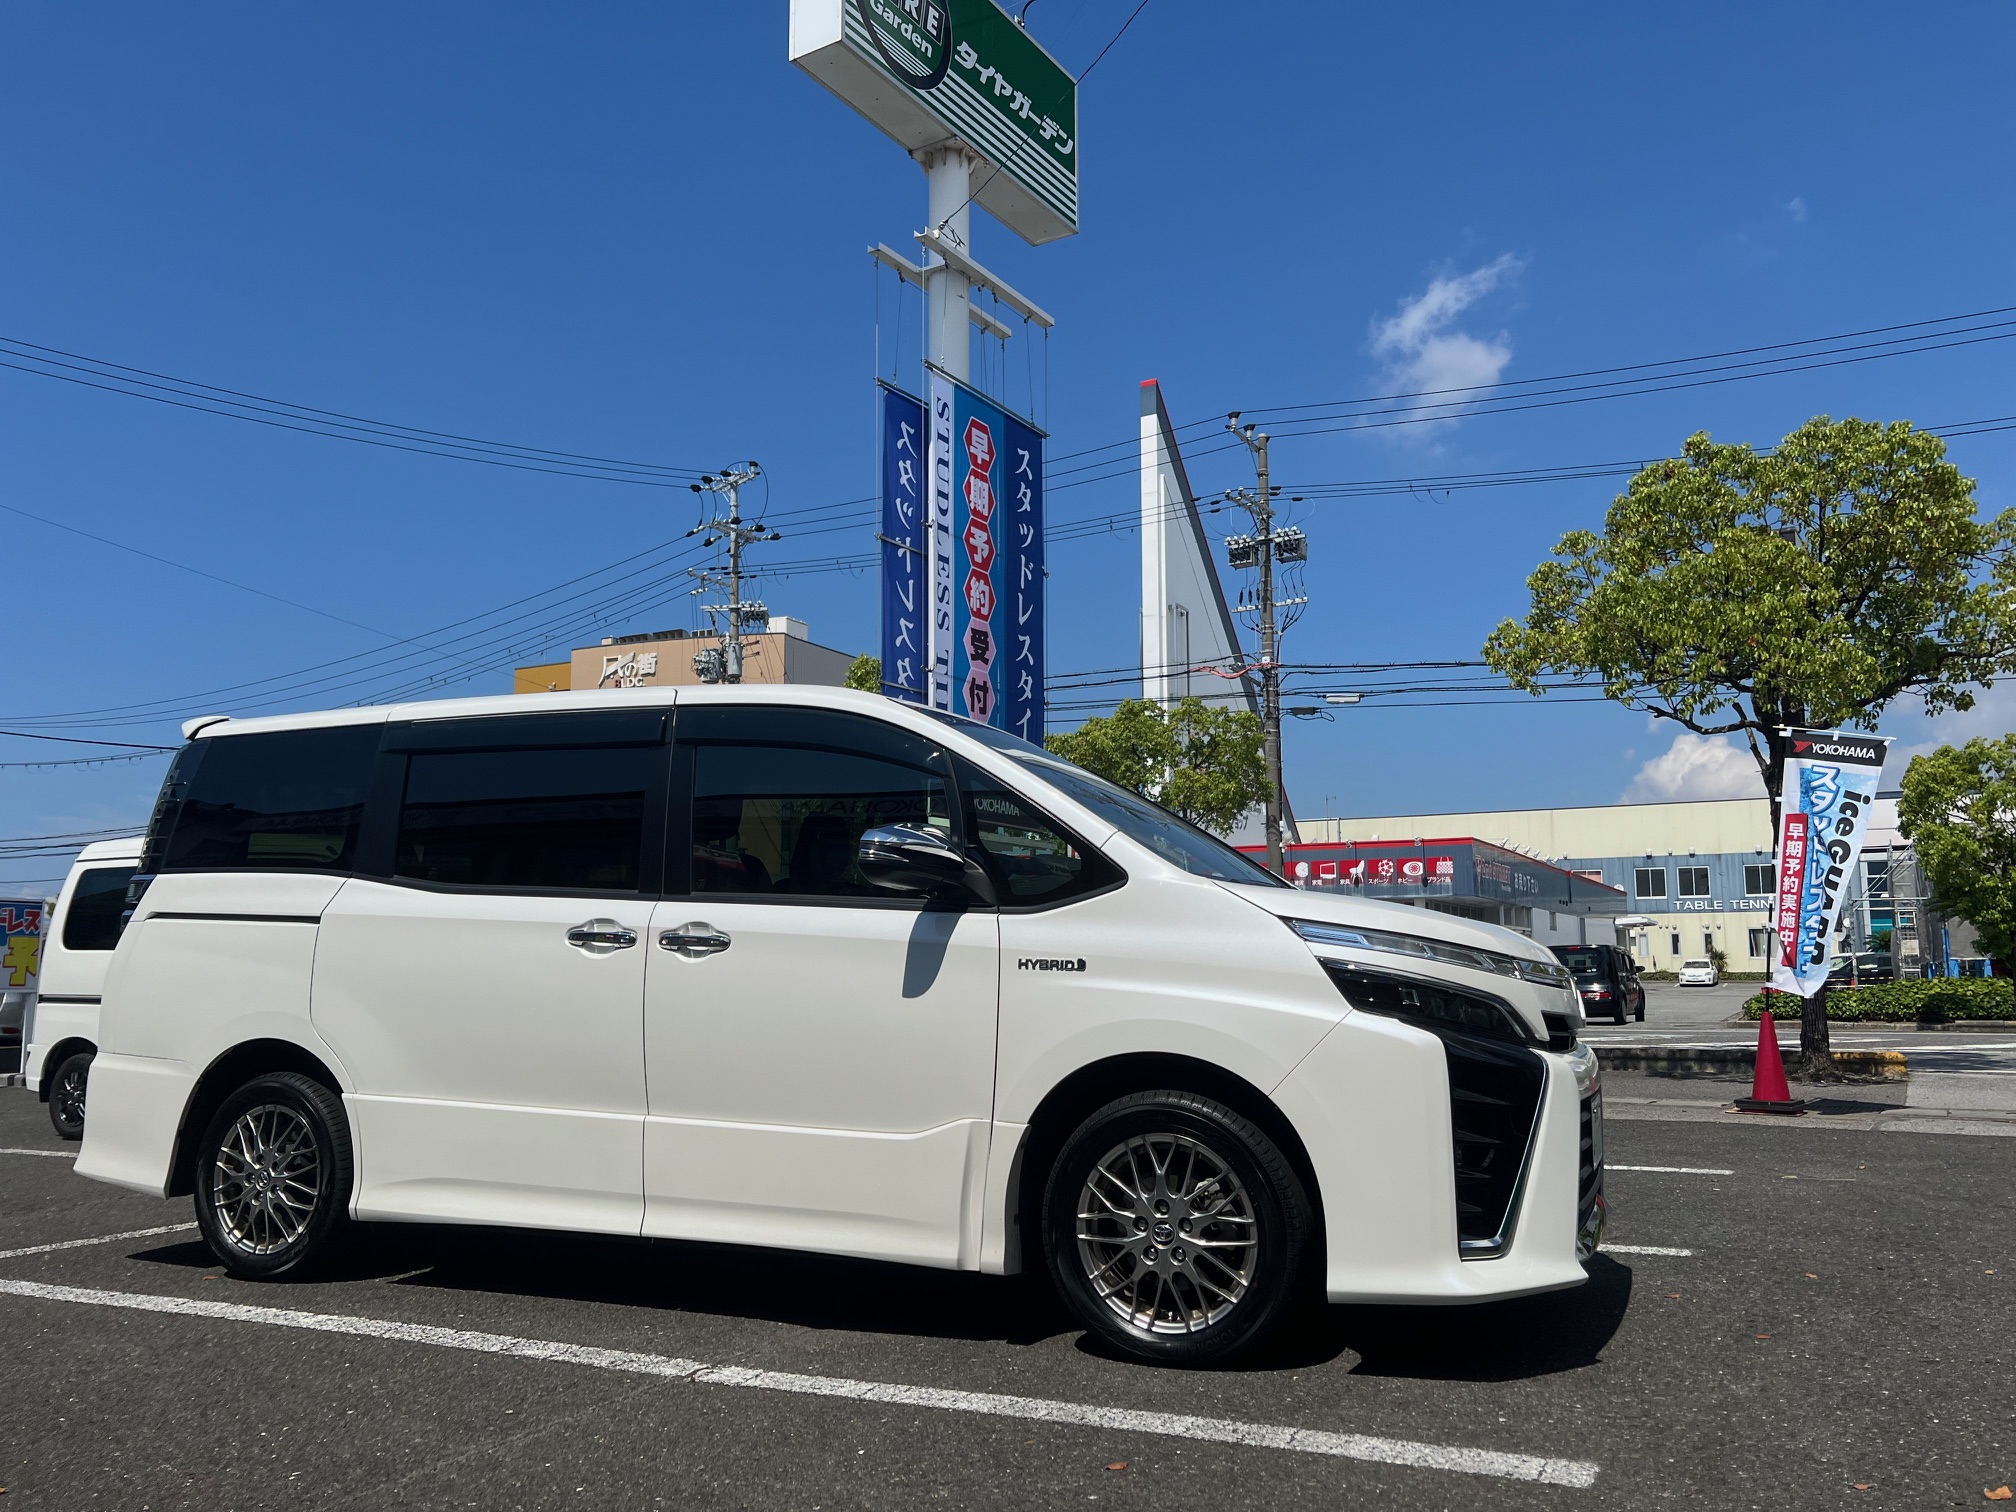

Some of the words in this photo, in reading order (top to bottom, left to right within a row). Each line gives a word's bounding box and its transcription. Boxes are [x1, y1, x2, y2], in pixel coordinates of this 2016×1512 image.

[869, 0, 933, 58] Garden
[955, 41, 1073, 154] タイヤガーデン
[936, 397, 950, 632] STUDLESS
[969, 427, 990, 715] 早期予約受付
[1014, 448, 1034, 740] スタッドレスタイ
[1811, 742, 1876, 759] YOKOHAMA
[1673, 900, 1723, 910] TABLE
[1017, 958, 1075, 972] HYBRID
